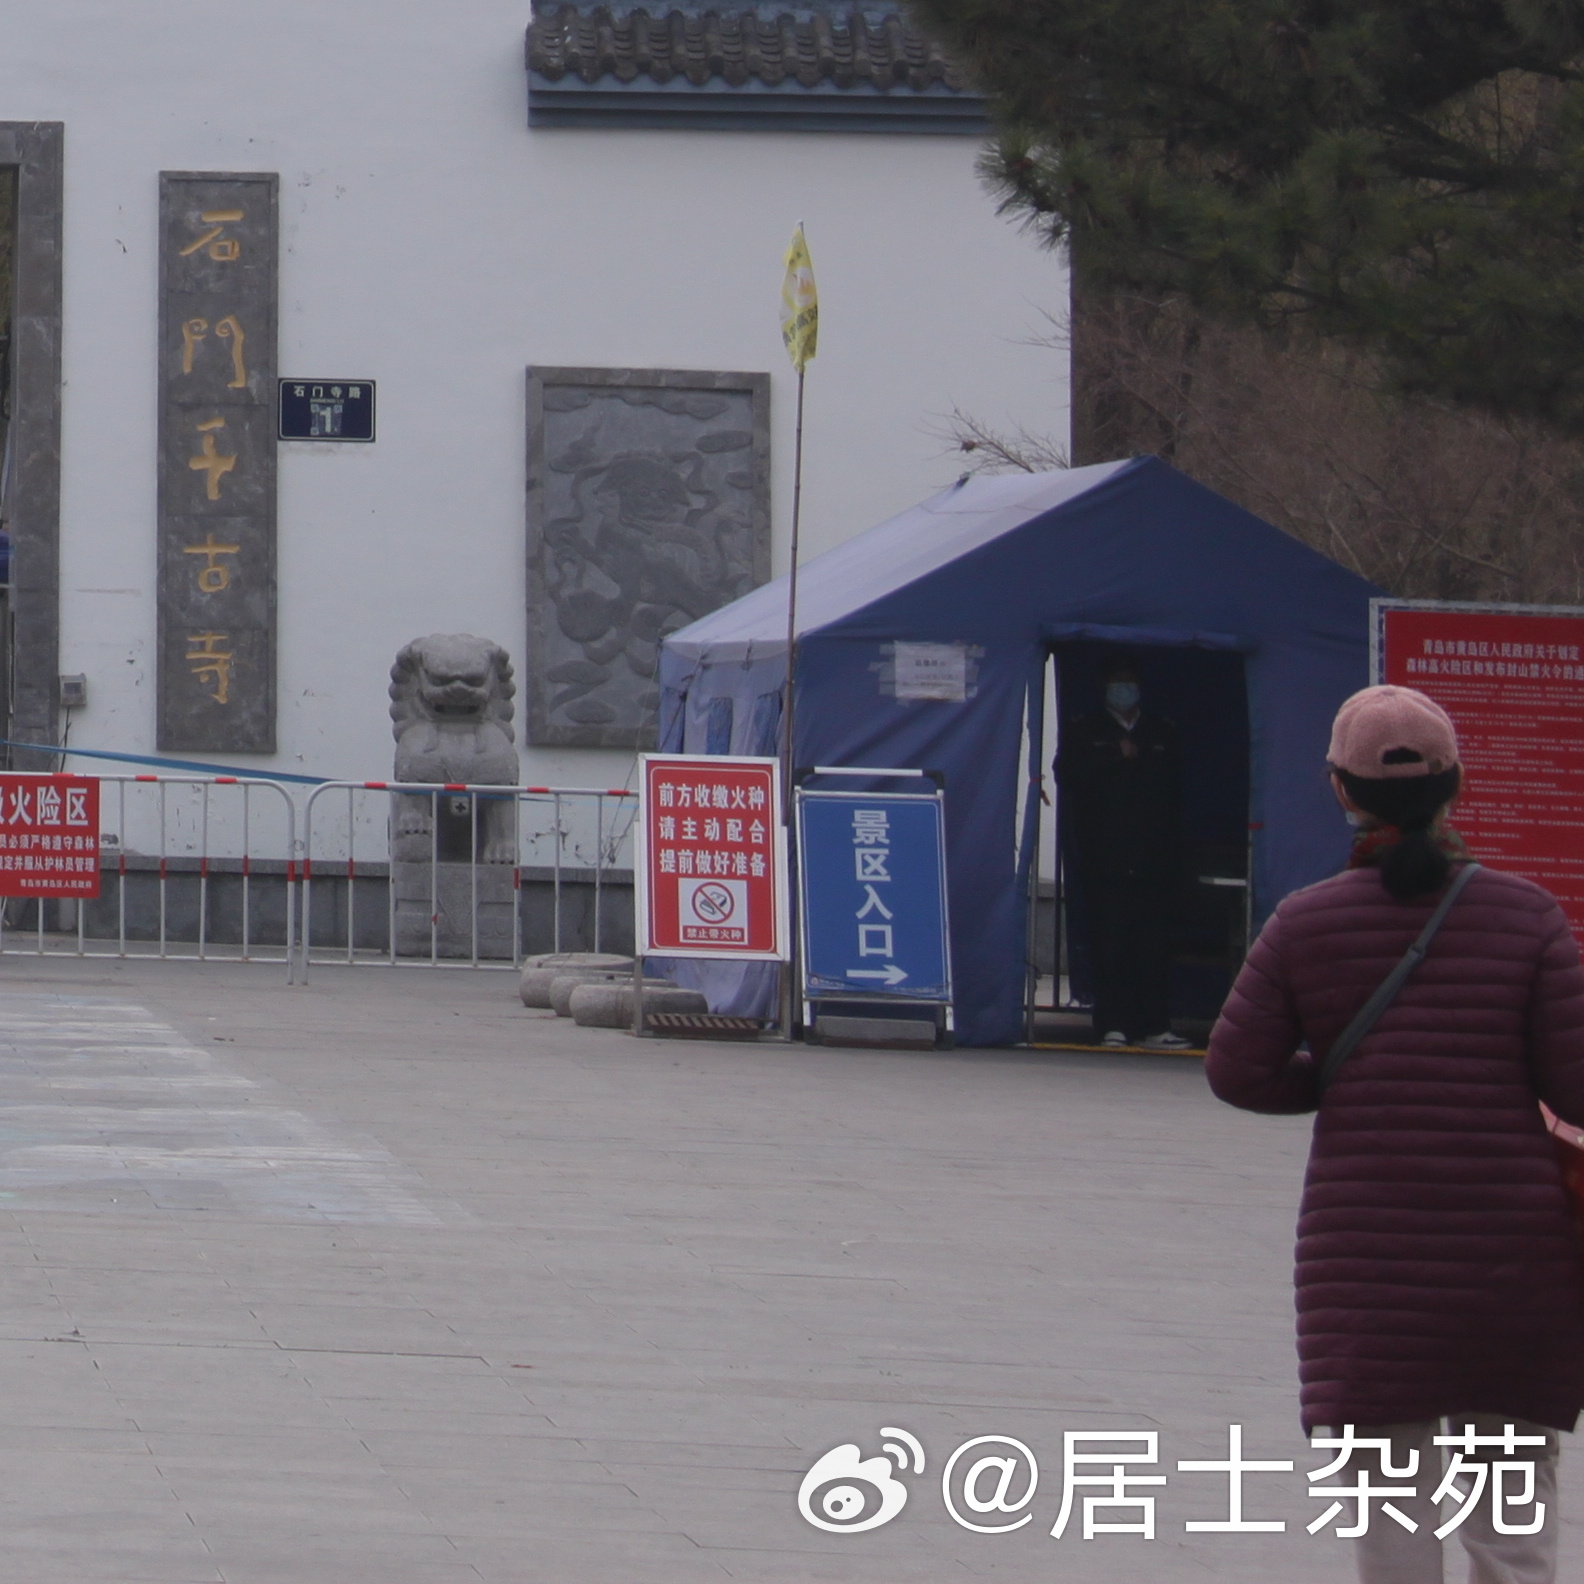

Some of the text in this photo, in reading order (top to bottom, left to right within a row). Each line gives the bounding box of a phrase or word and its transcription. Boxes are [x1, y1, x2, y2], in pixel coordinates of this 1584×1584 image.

[319, 406, 333, 434] 1
[658, 782, 765, 810] 前方收缴火种
[658, 815, 765, 844] 请主动配合
[659, 848, 766, 877] 提前做好准备
[851, 809, 894, 958] 景区入口
[686, 926, 743, 940] 禁止带火种
